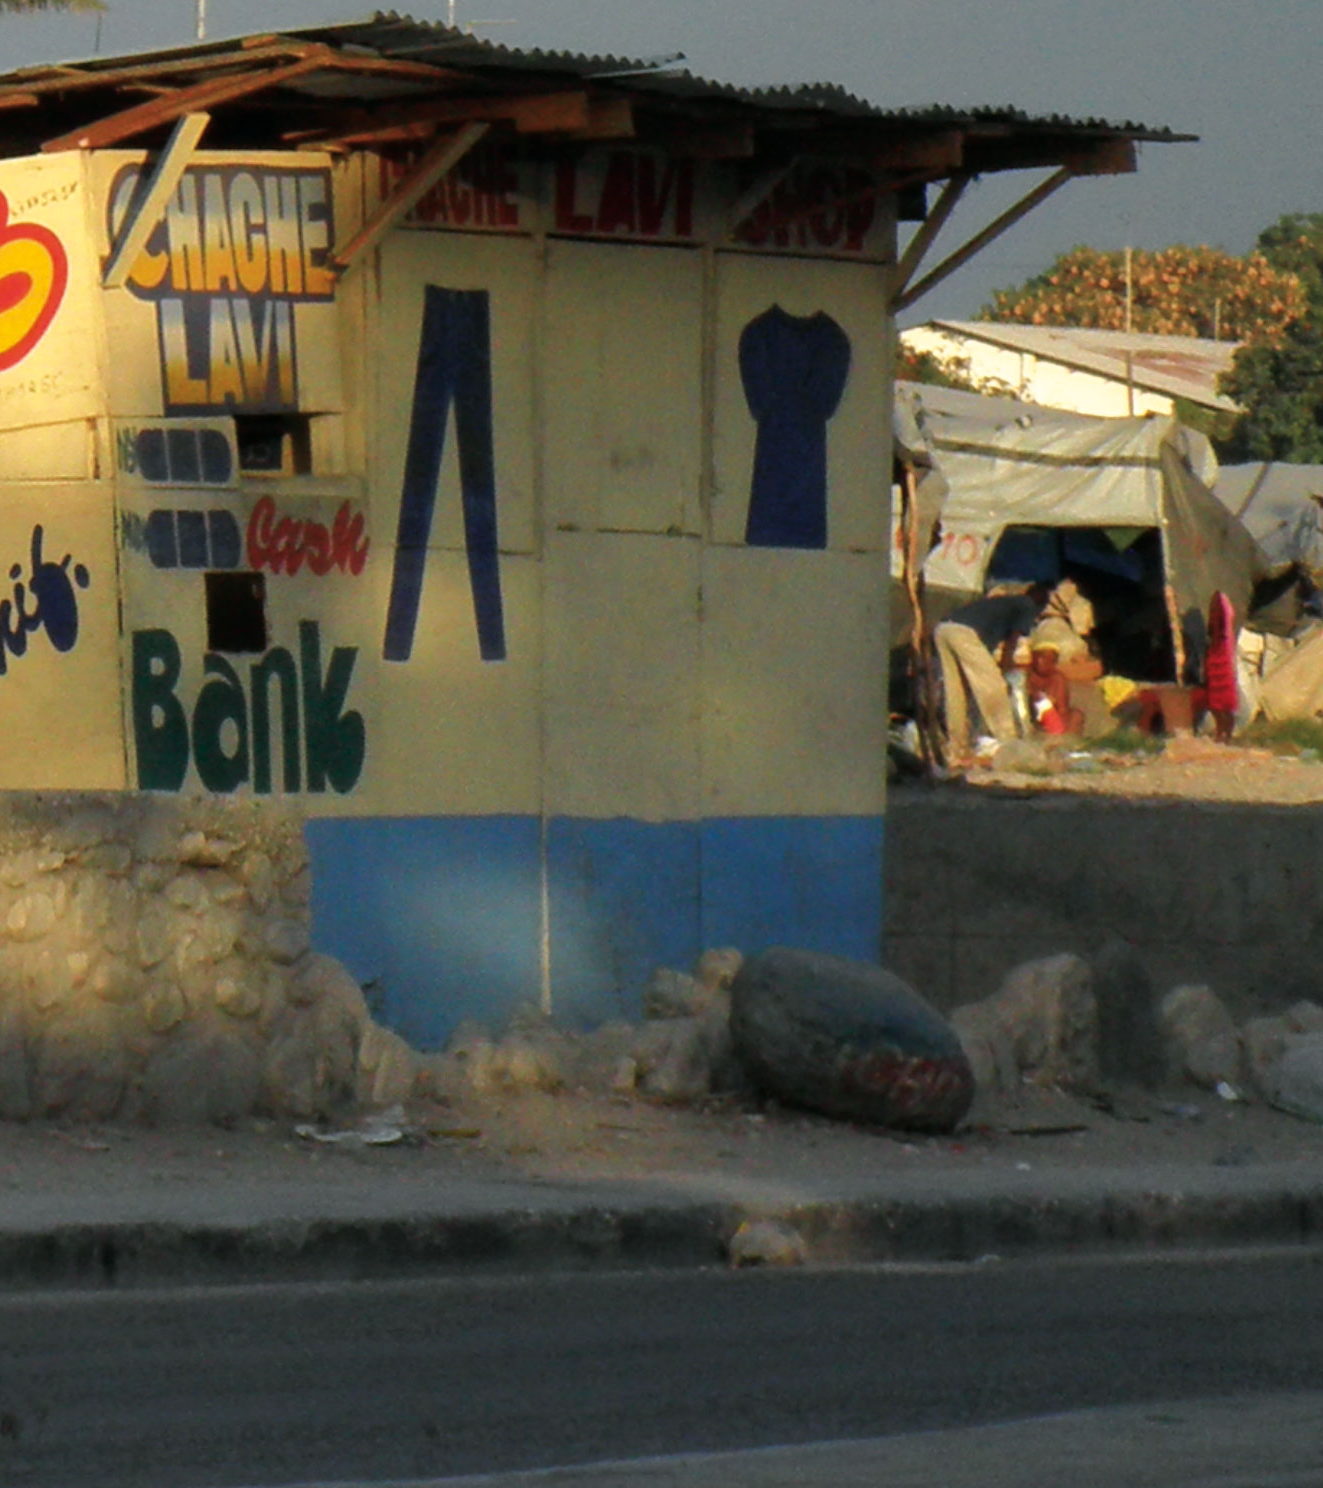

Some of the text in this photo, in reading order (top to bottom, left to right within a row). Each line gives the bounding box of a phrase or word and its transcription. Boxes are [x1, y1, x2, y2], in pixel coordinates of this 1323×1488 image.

[555, 150, 695, 238] LAVI
[158, 297, 297, 407] LAVI
[246, 494, 371, 578] Cash
[131, 619, 366, 796] Bank
